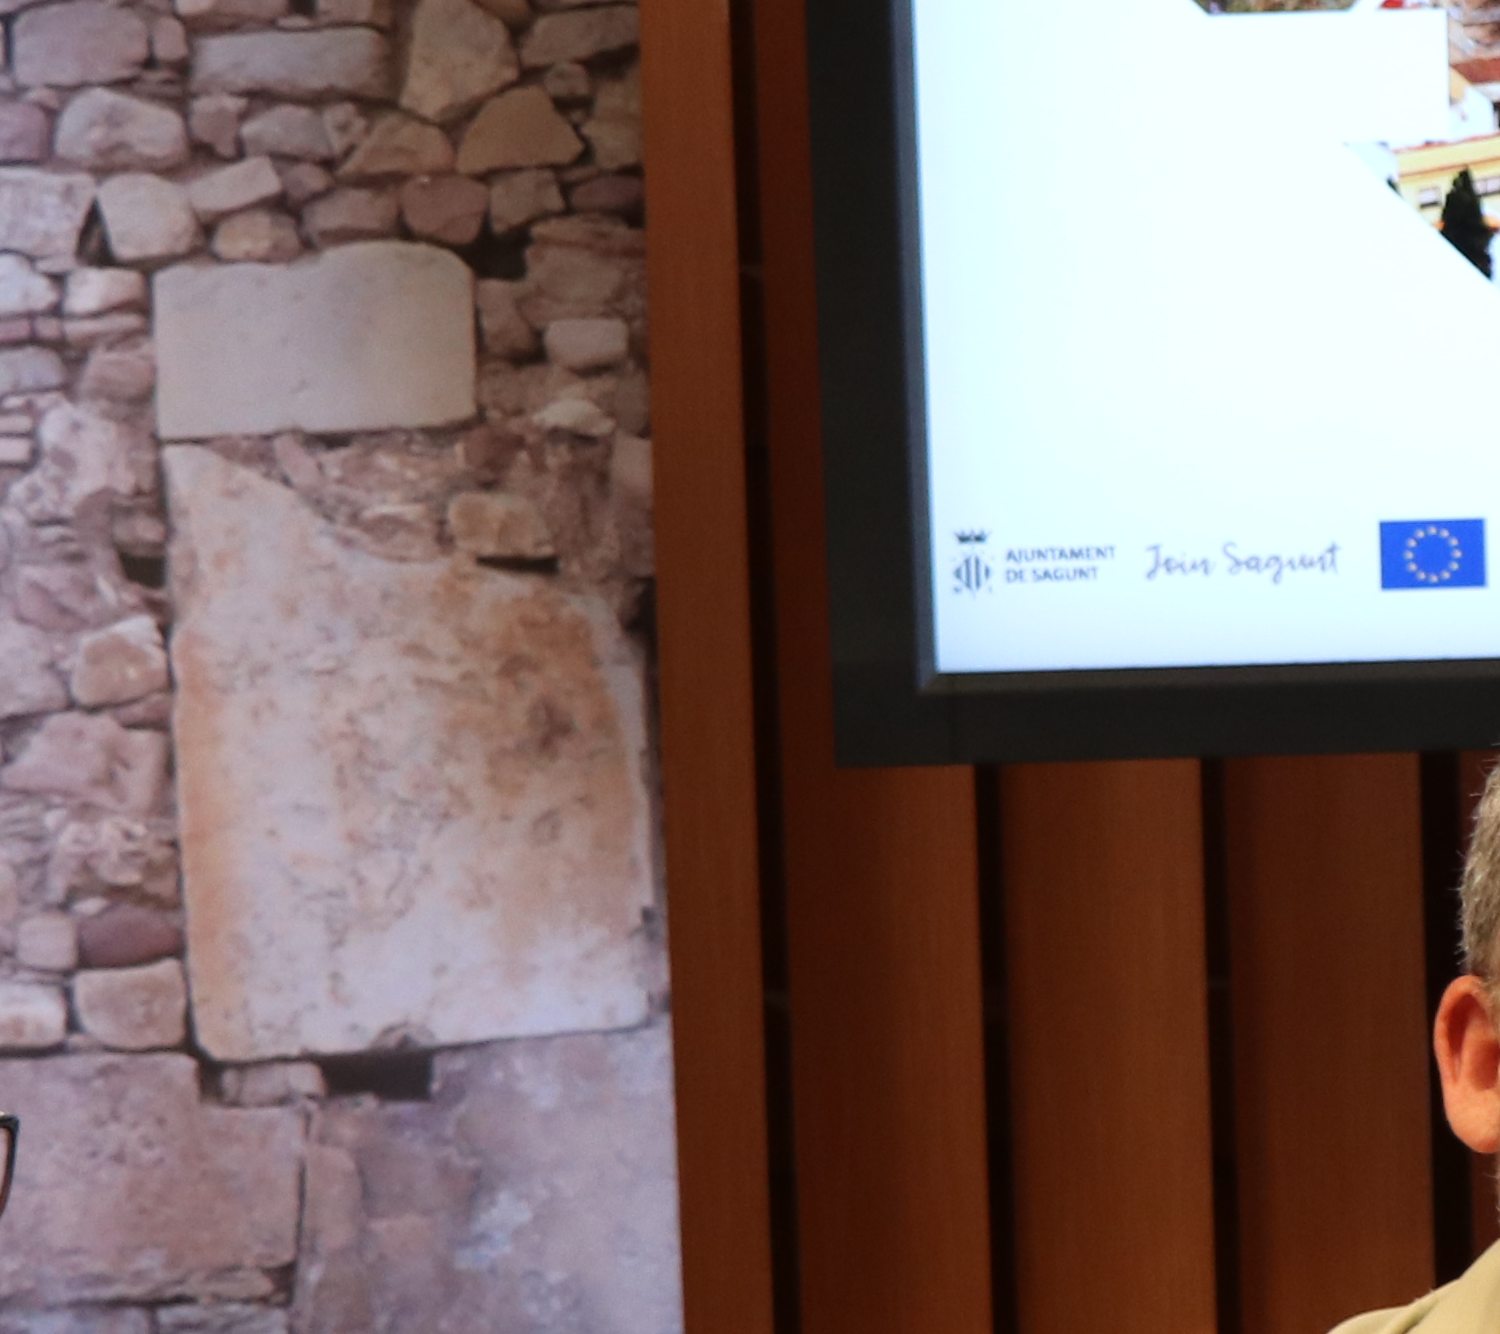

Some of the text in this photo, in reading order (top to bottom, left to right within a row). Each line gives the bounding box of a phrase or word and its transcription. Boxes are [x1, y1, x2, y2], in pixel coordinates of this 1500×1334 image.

[1006, 545, 1116, 564] AJUNTAMENT
[1222, 541, 1341, 585] Sagunt
[1006, 567, 1099, 584] DE SAGUNT
